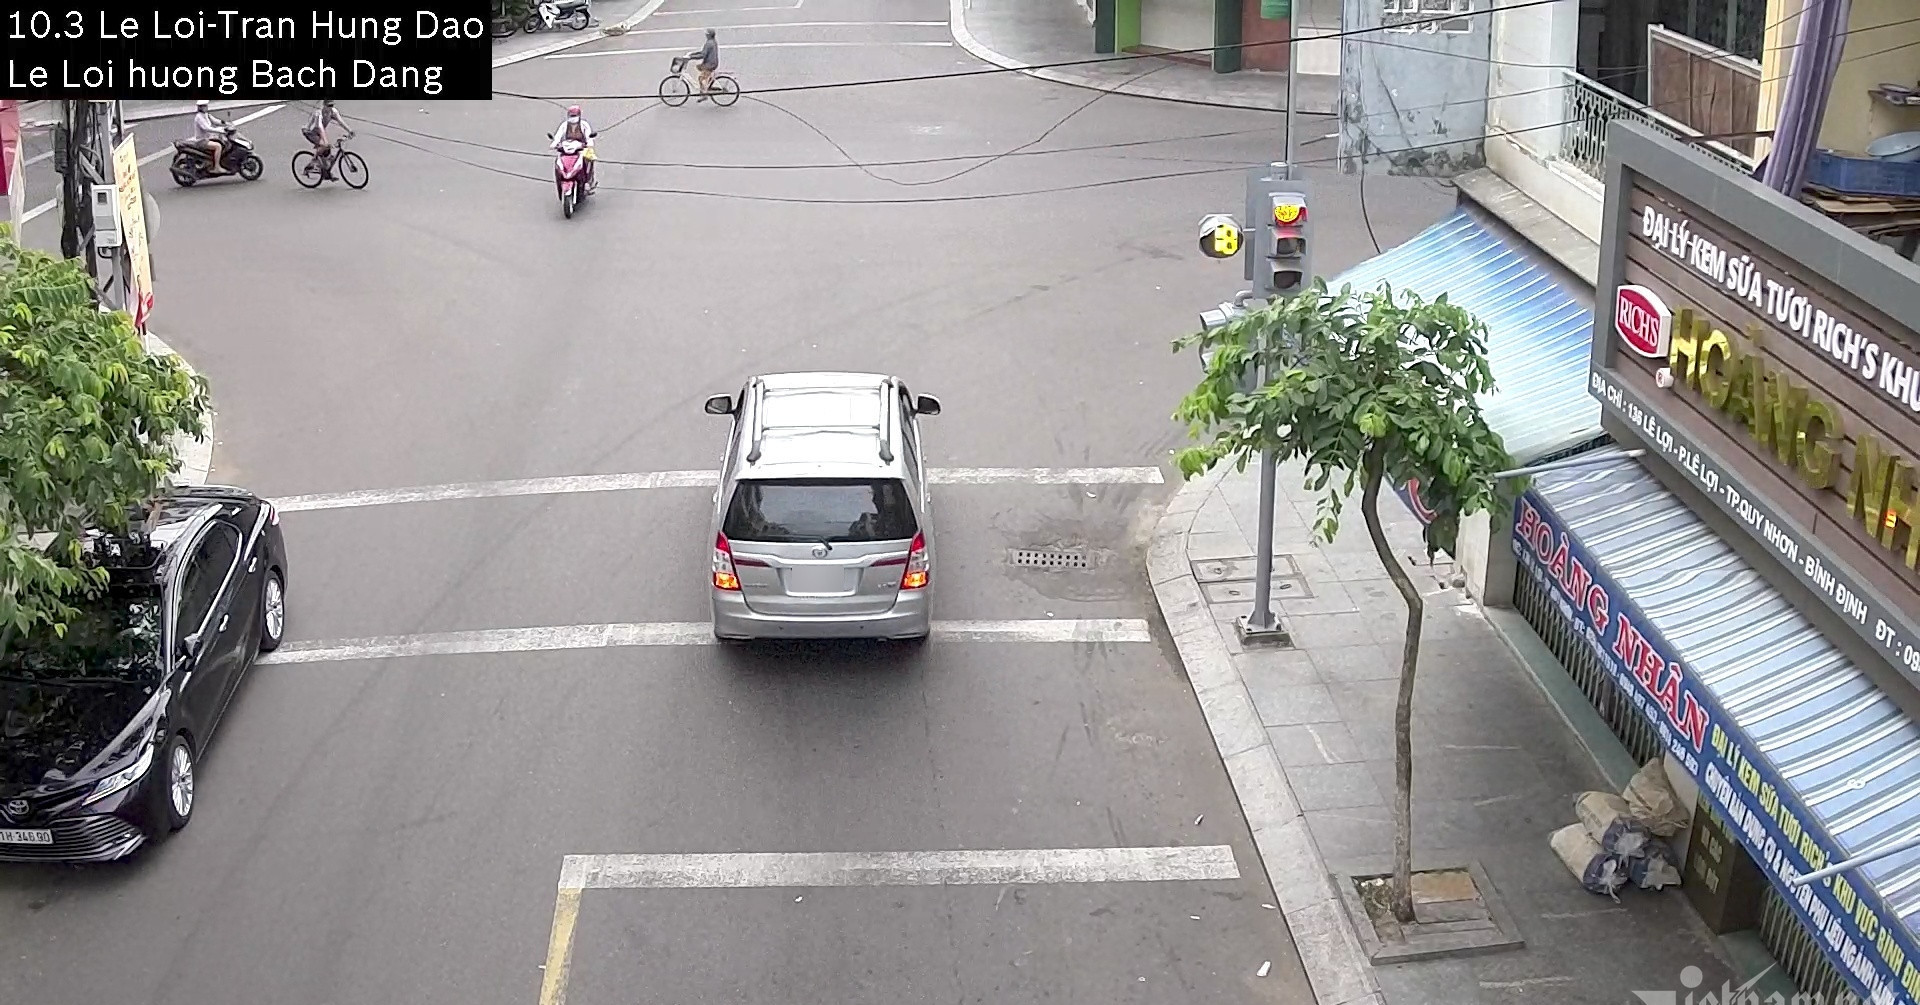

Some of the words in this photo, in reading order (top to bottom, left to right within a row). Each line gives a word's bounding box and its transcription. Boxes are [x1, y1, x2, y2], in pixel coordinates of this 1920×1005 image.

[1642, 205, 1670, 250] ĐẠI
[1670, 219, 1690, 259] LÝ
[1690, 234, 1727, 283] KEM
[1727, 254, 1763, 307] SỮA
[1766, 279, 1812, 338] TƯƠI
[1812, 308, 1880, 380] RICH'S
[1669, 306, 1846, 491] HOÀNG
[1643, 414, 1656, 438] LÊ
[1763, 519, 1799, 563] NHƠN
[1835, 582, 1869, 625] ĐỊNH
[1514, 496, 1612, 637] HOÀNG
[1612, 611, 1710, 754] NHÂN
[1737, 755, 1761, 798] KEM
[1832, 873, 1857, 914] KHU
